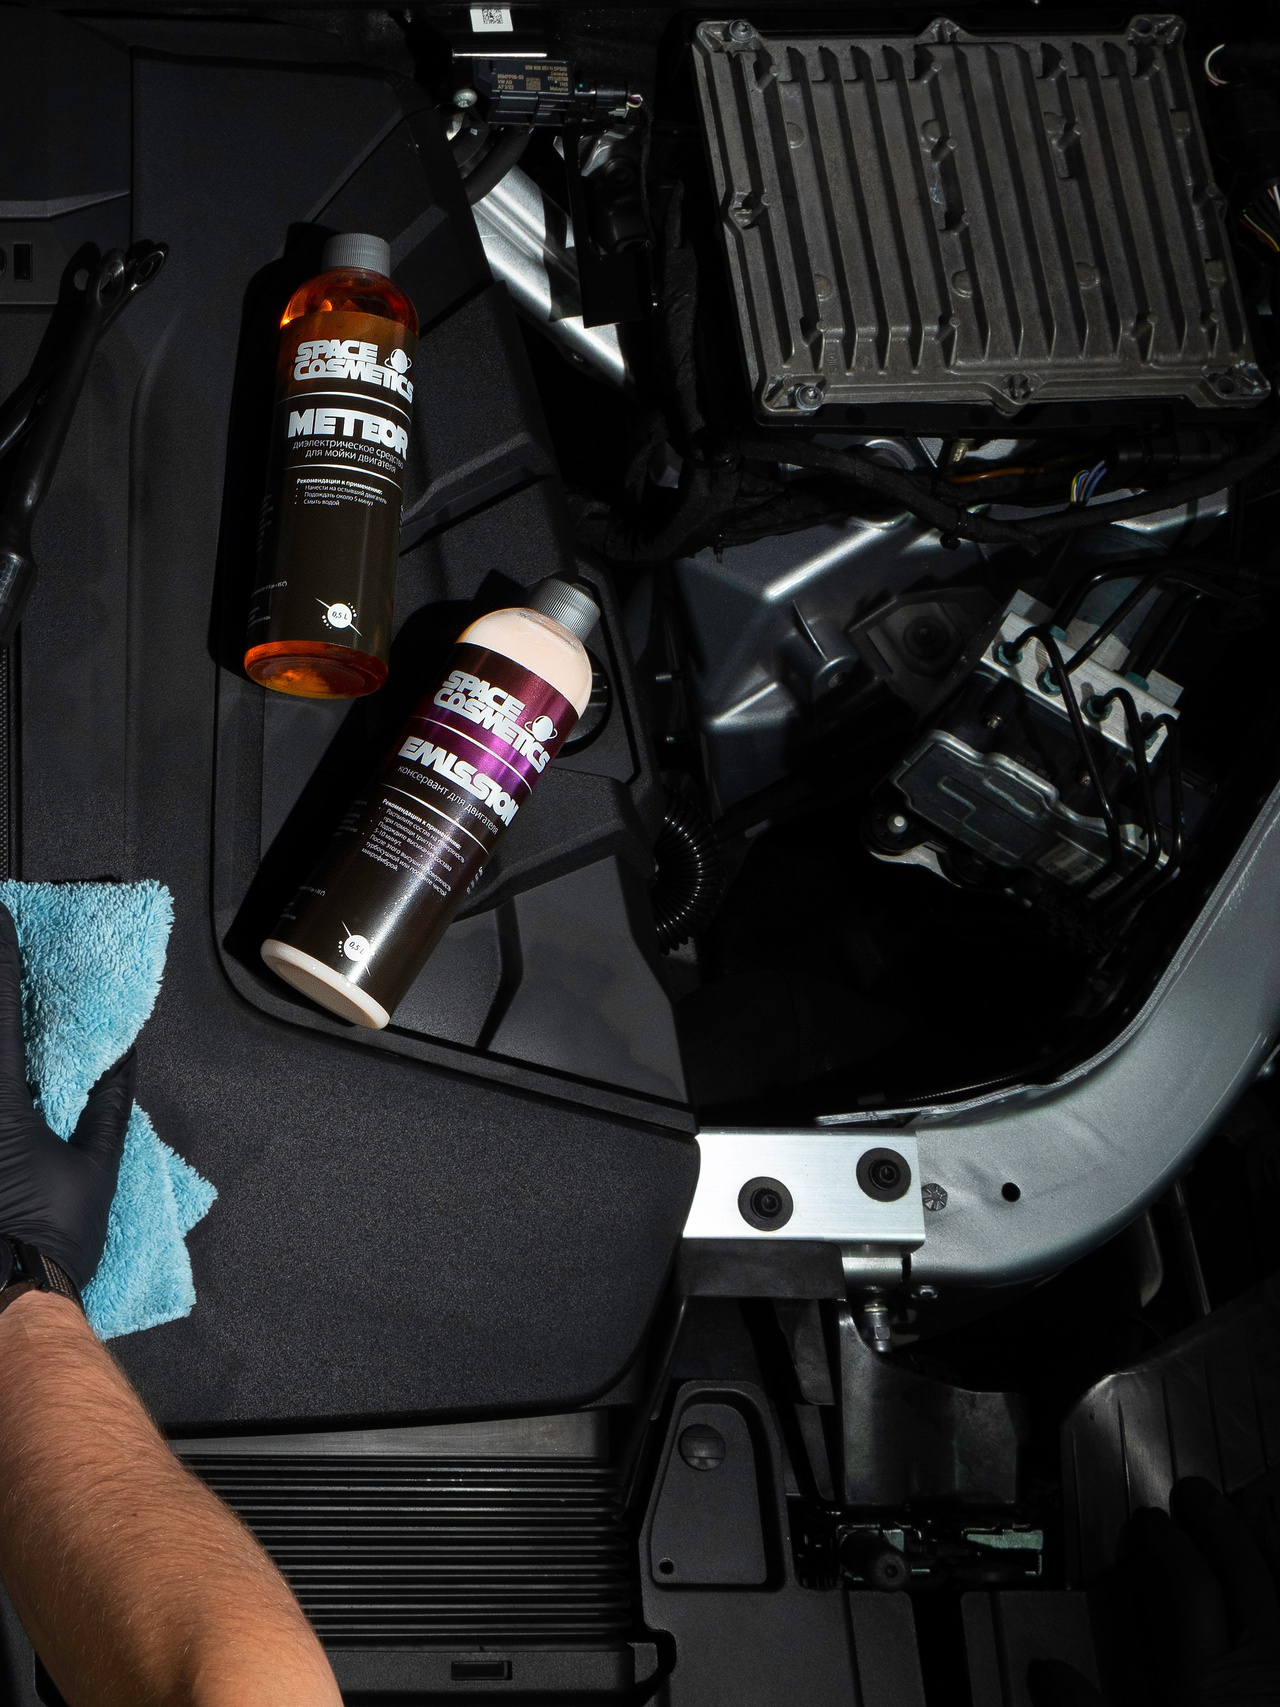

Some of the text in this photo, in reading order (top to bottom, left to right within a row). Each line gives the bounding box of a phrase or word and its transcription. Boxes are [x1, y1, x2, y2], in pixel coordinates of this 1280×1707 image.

[294, 339, 379, 364] SPACE
[292, 358, 414, 404] COSMETICS
[287, 407, 410, 460] METEOR
[293, 440, 403, 469] диэлектрическое средство
[305, 449, 396, 473] для мойки двигателя
[337, 487, 365, 496] остывший
[346, 481, 383, 495] применению:
[358, 498, 373, 506] минут
[442, 670, 525, 721] SPACE
[433, 688, 551, 774] COSMETICS
[398, 735, 520, 827] EMISSION
[398, 766, 498, 834] консервант для двигателя
[382, 798, 422, 823] Рекомендации
[426, 823, 461, 850] применению:
[383, 816, 394, 824] при
[386, 808, 413, 827] Распылите
[413, 824, 431, 837] состав
[370, 834, 386, 846] После
[374, 828, 402, 846] 5-10 минут.
[378, 821, 407, 841] Подождите
[432, 854, 452, 872] состава
[361, 848, 398, 871] микрофиброй.
[349, 942, 360, 950] 0,5
